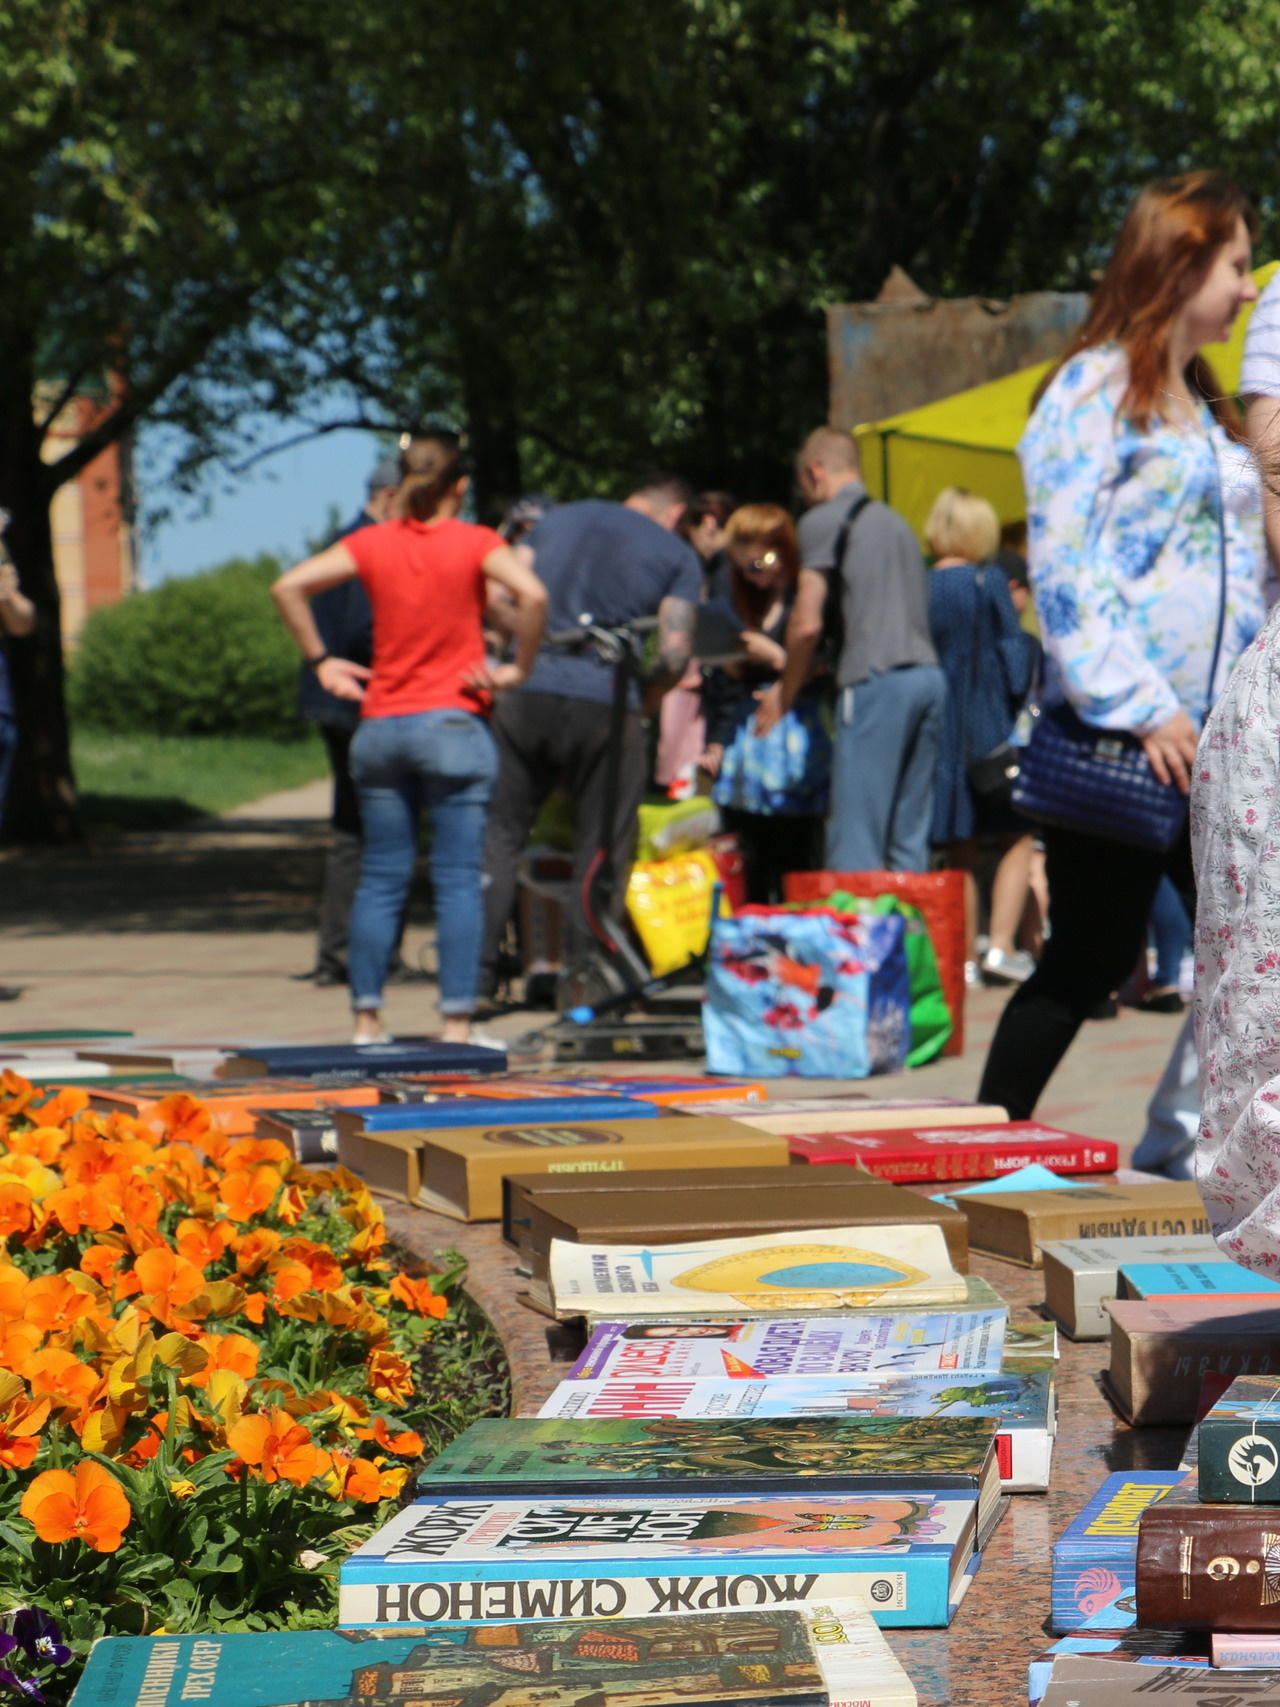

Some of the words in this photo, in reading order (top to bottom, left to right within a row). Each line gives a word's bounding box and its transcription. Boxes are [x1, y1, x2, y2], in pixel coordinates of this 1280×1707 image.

[762, 1321, 808, 1345] ДИЕТА
[752, 1346, 797, 1374] НОВАЯ
[796, 1362, 834, 1374] ПО
[838, 1350, 874, 1373] ВКУСУ
[385, 1503, 495, 1556] ЖОРЖ
[462, 1511, 522, 1545] СТРИПТИЗ
[505, 1516, 581, 1538] СИ
[568, 1514, 644, 1538] МЕ
[626, 1510, 709, 1542] НОН
[376, 1577, 626, 1623] СИМЕНОН
[646, 1574, 819, 1613] ЖОРЖ
[109, 1643, 133, 1669] ФУРСОВ
[188, 1640, 223, 1670] ОЗЕР
[134, 1642, 181, 1707] ПЛЕННИКИ
[181, 1671, 217, 1700] ТРЕХ
